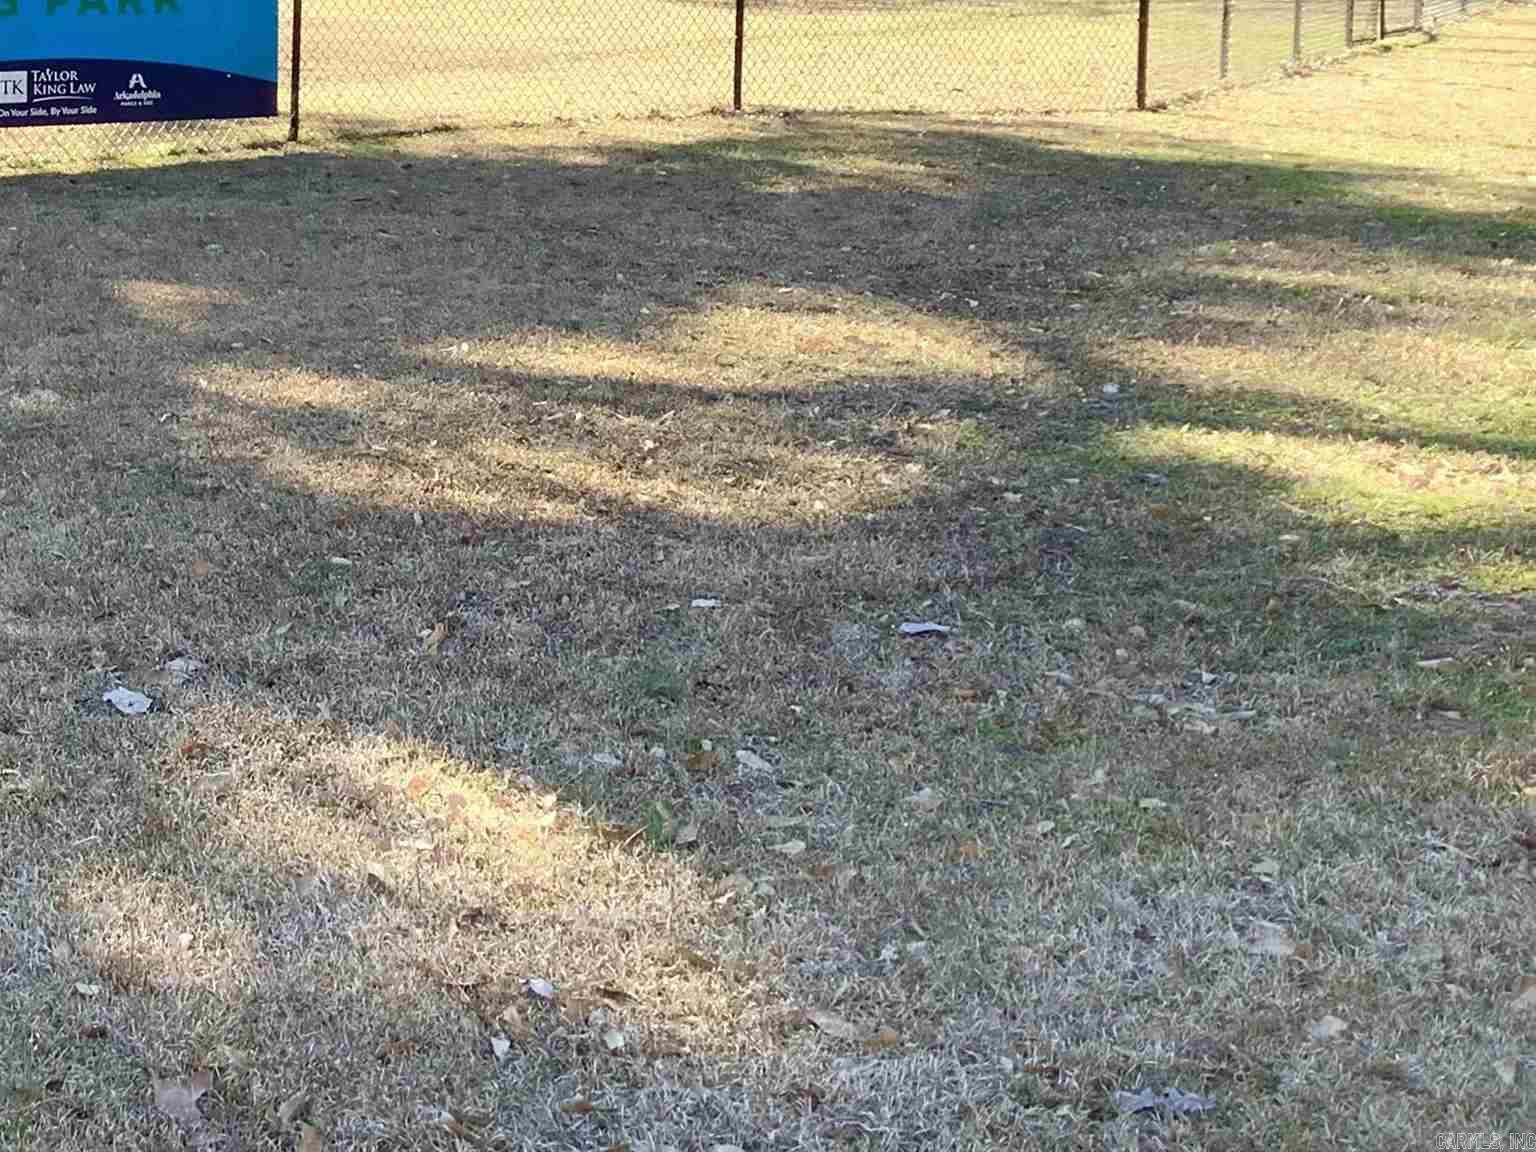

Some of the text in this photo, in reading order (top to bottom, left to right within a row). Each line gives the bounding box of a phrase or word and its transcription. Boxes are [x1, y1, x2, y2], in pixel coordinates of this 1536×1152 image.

[31, 68, 79, 82] TAYLOR
[0, 79, 24, 96] TK
[33, 82, 97, 96] KING LAW
[10, 108, 29, 117] Your
[50, 106, 61, 117] By
